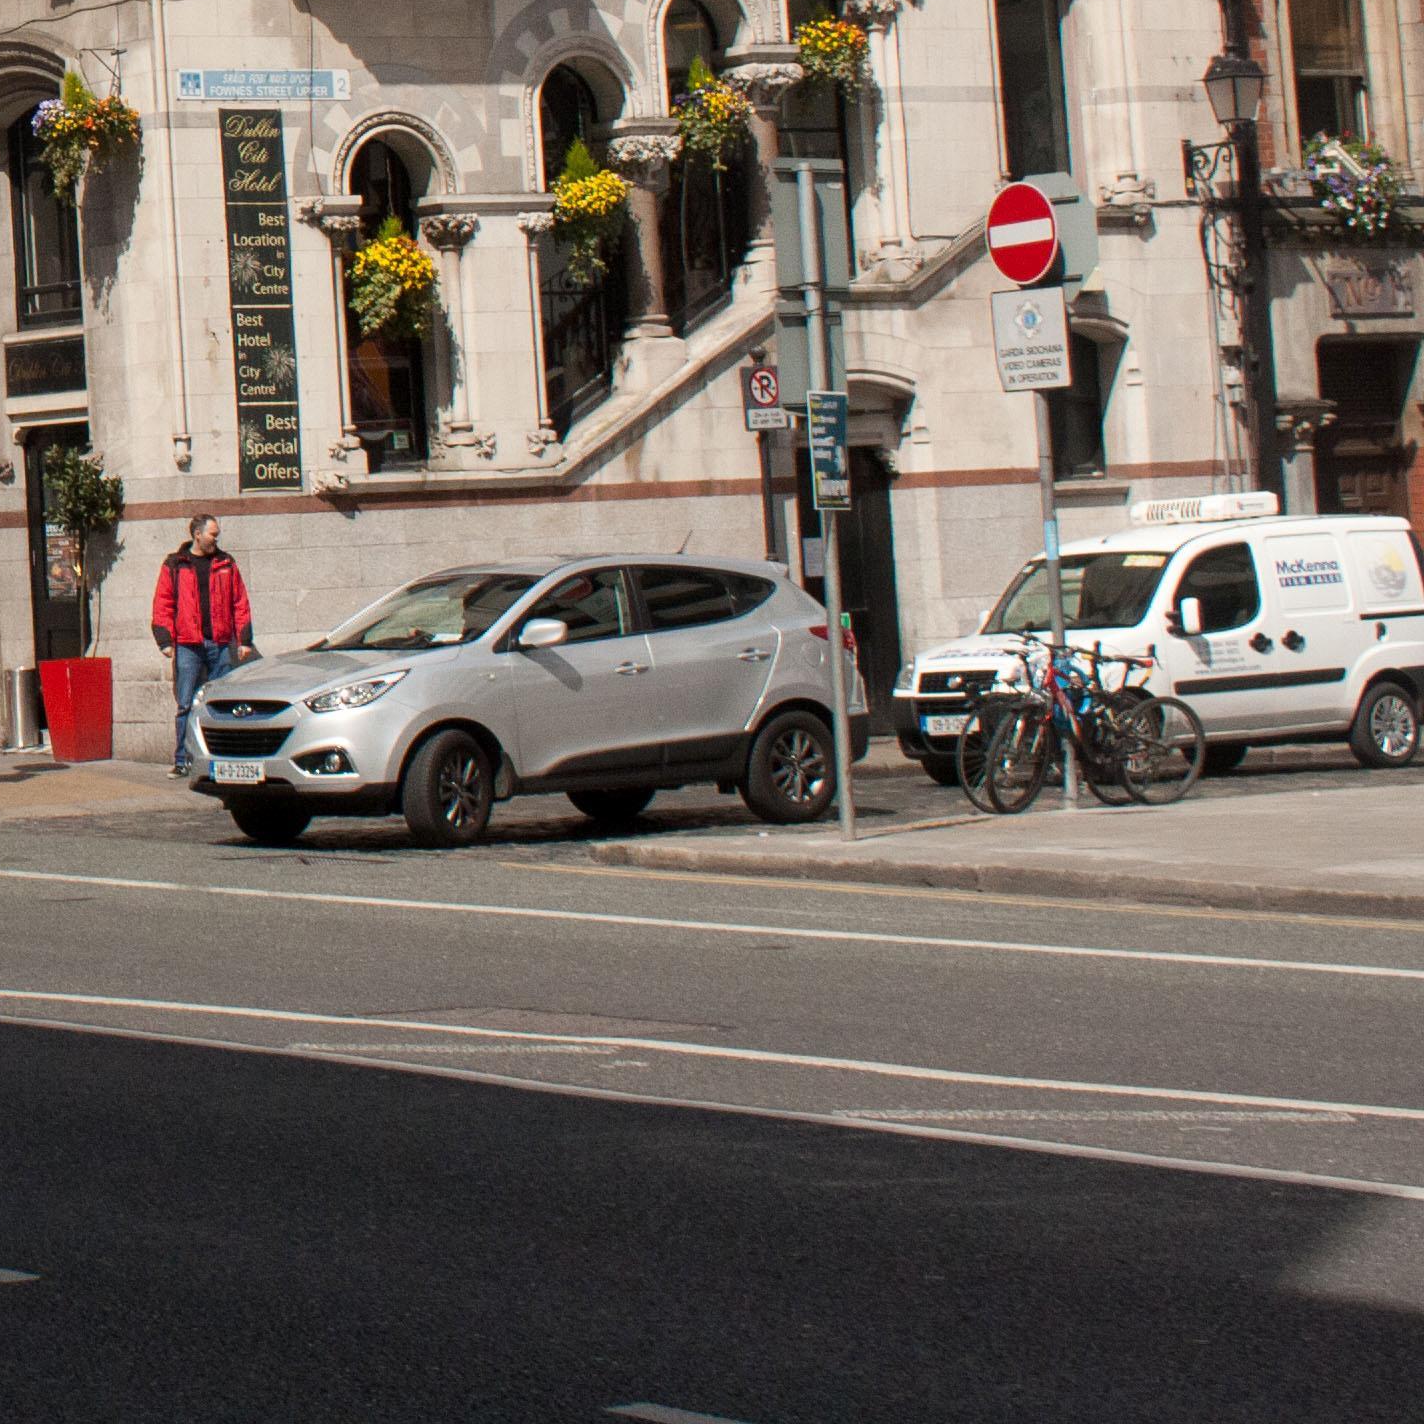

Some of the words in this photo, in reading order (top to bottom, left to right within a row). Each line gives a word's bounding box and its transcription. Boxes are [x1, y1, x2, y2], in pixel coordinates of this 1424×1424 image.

[210, 86, 252, 96] FOWNES
[256, 86, 291, 96] STREET
[296, 86, 328, 96] UPPER
[336, 78, 346, 93] 2
[224, 115, 280, 138] Dublin
[229, 169, 282, 191] Hotel
[258, 212, 285, 226] Best
[233, 232, 285, 247] Location
[263, 264, 285, 280] City
[252, 282, 289, 295] Centre
[236, 313, 264, 327] Best
[237, 332, 271, 347] Hotel
[1025, 357, 1062, 368] CAMERAS
[239, 365, 261, 380] City
[1017, 372, 1058, 383] OPERATION
[240, 383, 276, 395] Centre
[265, 414, 298, 431] Best
[245, 437, 298, 460] Special
[255, 462, 300, 480] Offers
[1276, 558, 1339, 575] McKenna
